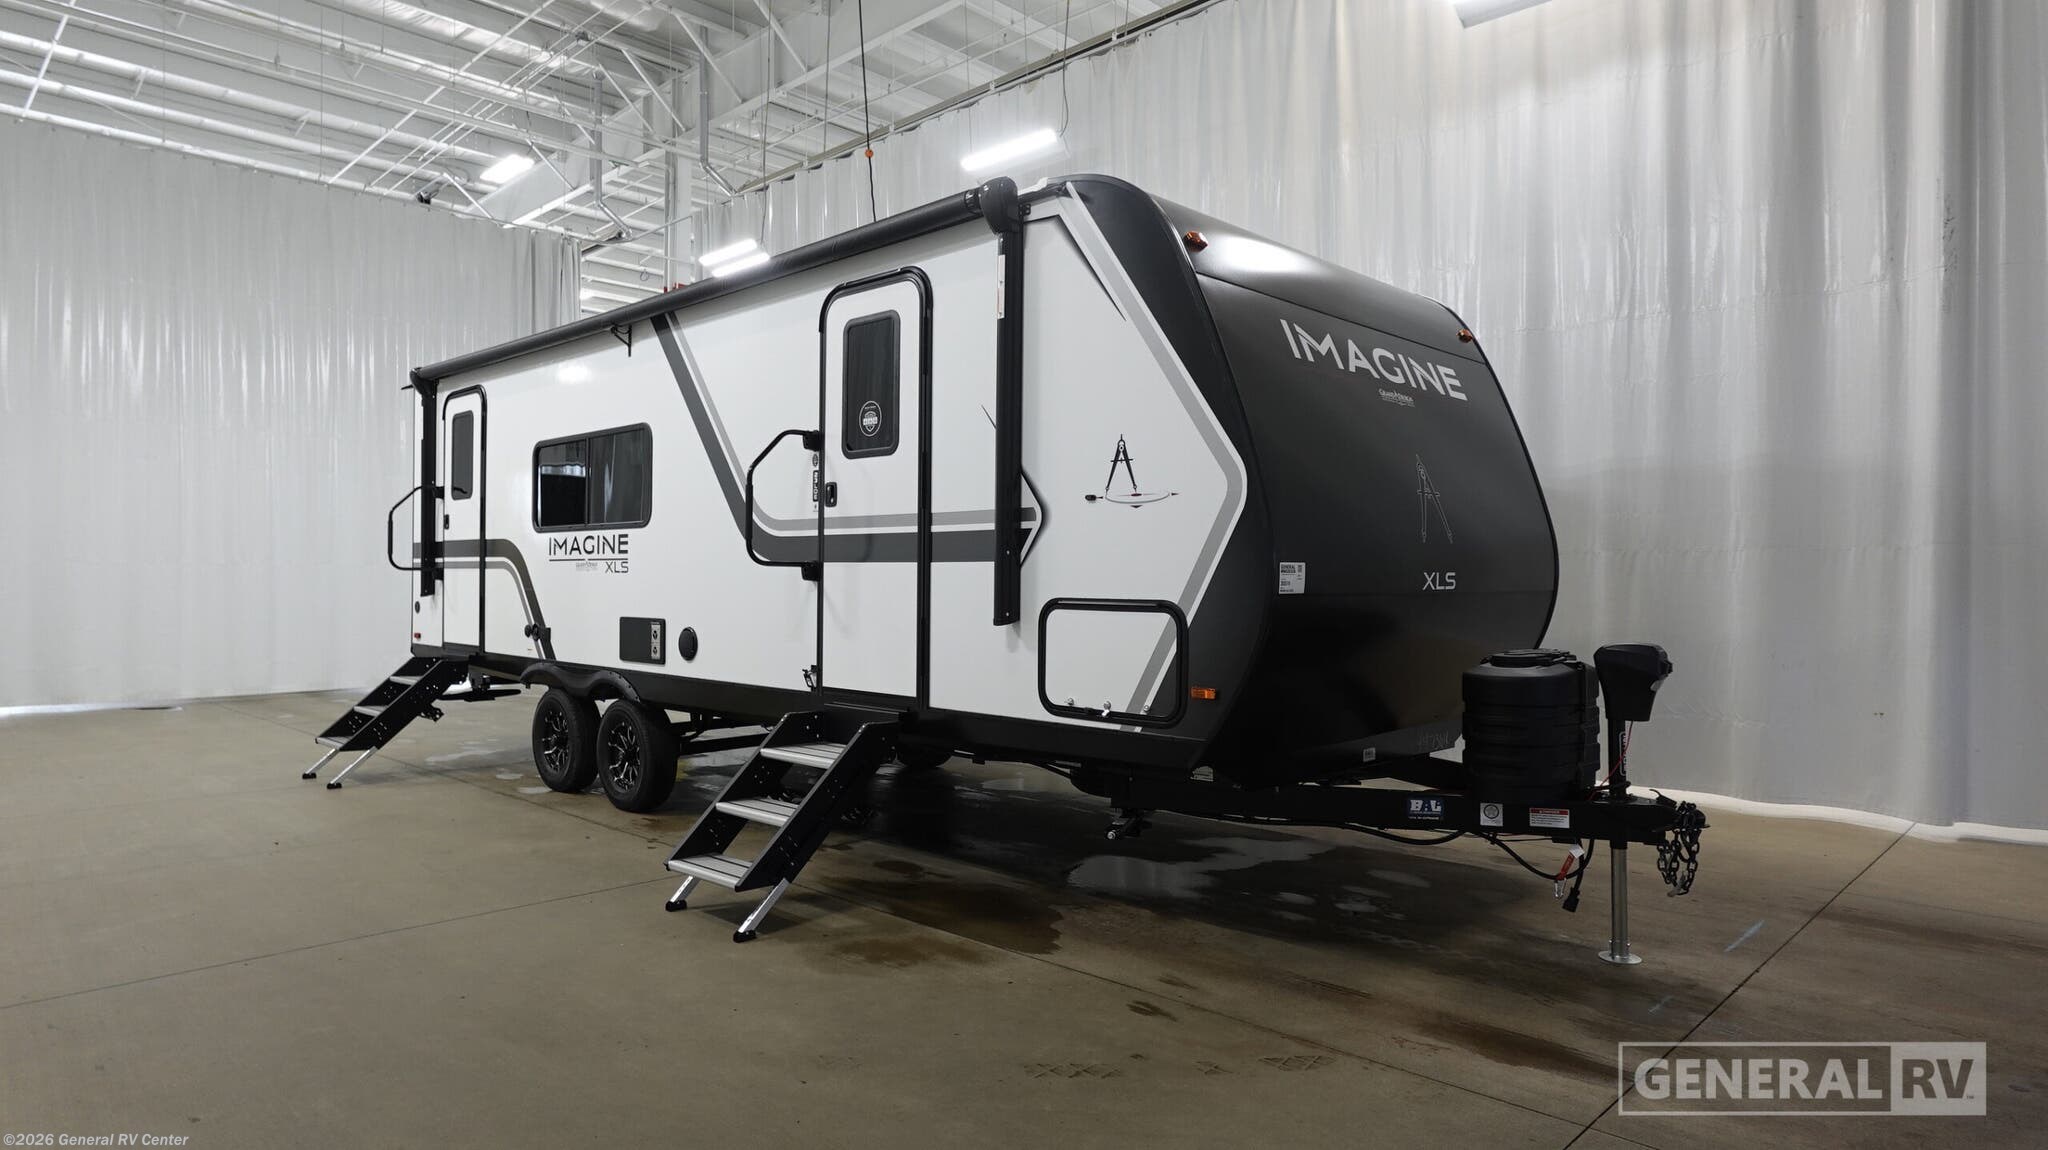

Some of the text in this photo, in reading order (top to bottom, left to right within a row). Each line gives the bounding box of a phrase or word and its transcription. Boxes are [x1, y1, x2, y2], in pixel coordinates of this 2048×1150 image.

[1279, 318, 1468, 401] IMAGINE
[548, 533, 629, 556] IMAGINE
[604, 560, 629, 574] XLS
[1422, 571, 1456, 591] XLS
